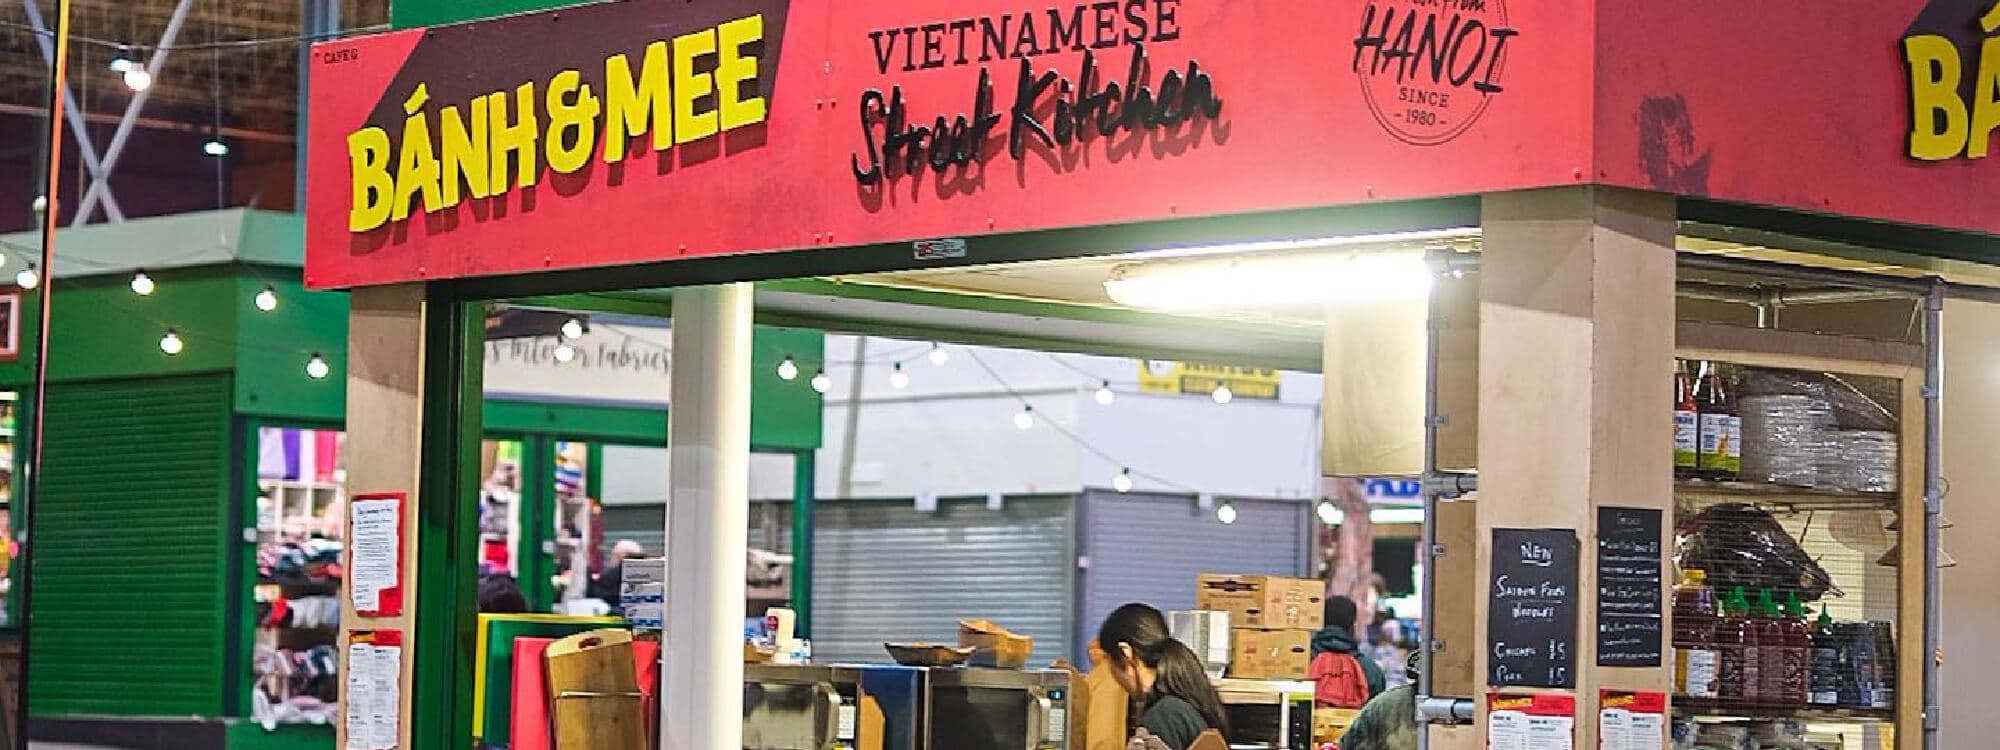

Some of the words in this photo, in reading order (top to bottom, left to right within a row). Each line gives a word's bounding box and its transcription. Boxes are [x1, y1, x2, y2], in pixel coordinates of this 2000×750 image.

[868, 0, 1181, 74] VIETNAMESE
[1353, 4, 1520, 98] HANOI
[852, 66, 1002, 186] Street
[1009, 39, 1221, 160] Kitchen
[1398, 87, 1451, 108] SINCE
